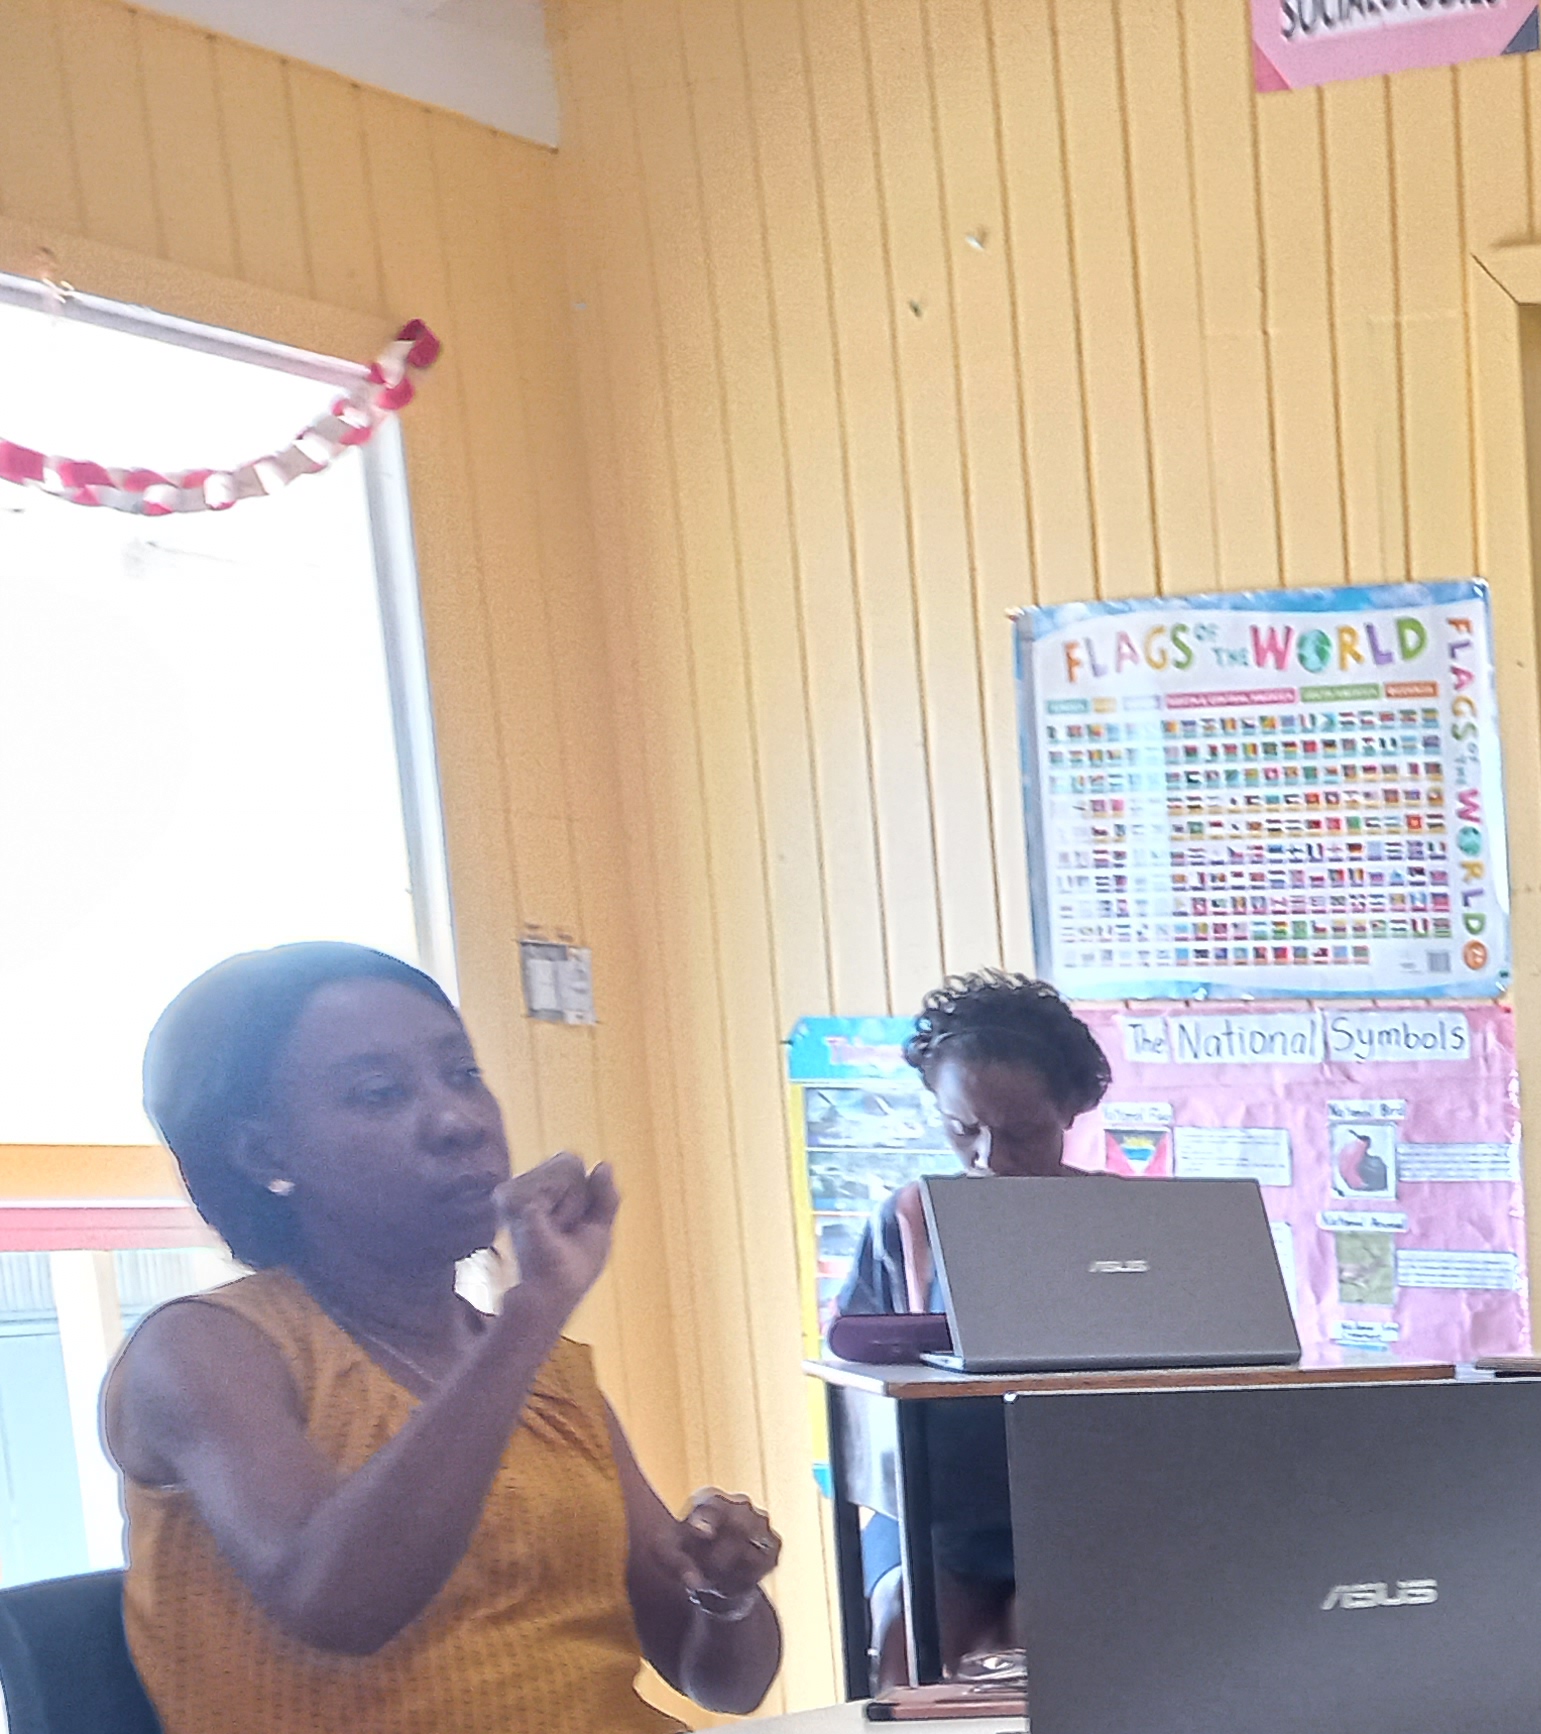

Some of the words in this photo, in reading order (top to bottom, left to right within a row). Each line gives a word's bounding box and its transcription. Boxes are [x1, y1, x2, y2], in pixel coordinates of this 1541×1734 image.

[1062, 623, 1194, 683] FLAGS
[1194, 623, 1220, 643] OF
[1212, 644, 1251, 669] THE
[1249, 616, 1428, 673] WORLD
[1446, 617, 1478, 742] FLAGS
[1457, 788, 1487, 936] WORLD
[1127, 1022, 1165, 1054] The
[1178, 1018, 1317, 1060] National
[1330, 1015, 1467, 1064] Symbols
[1320, 1578, 1439, 1611] ASUS
